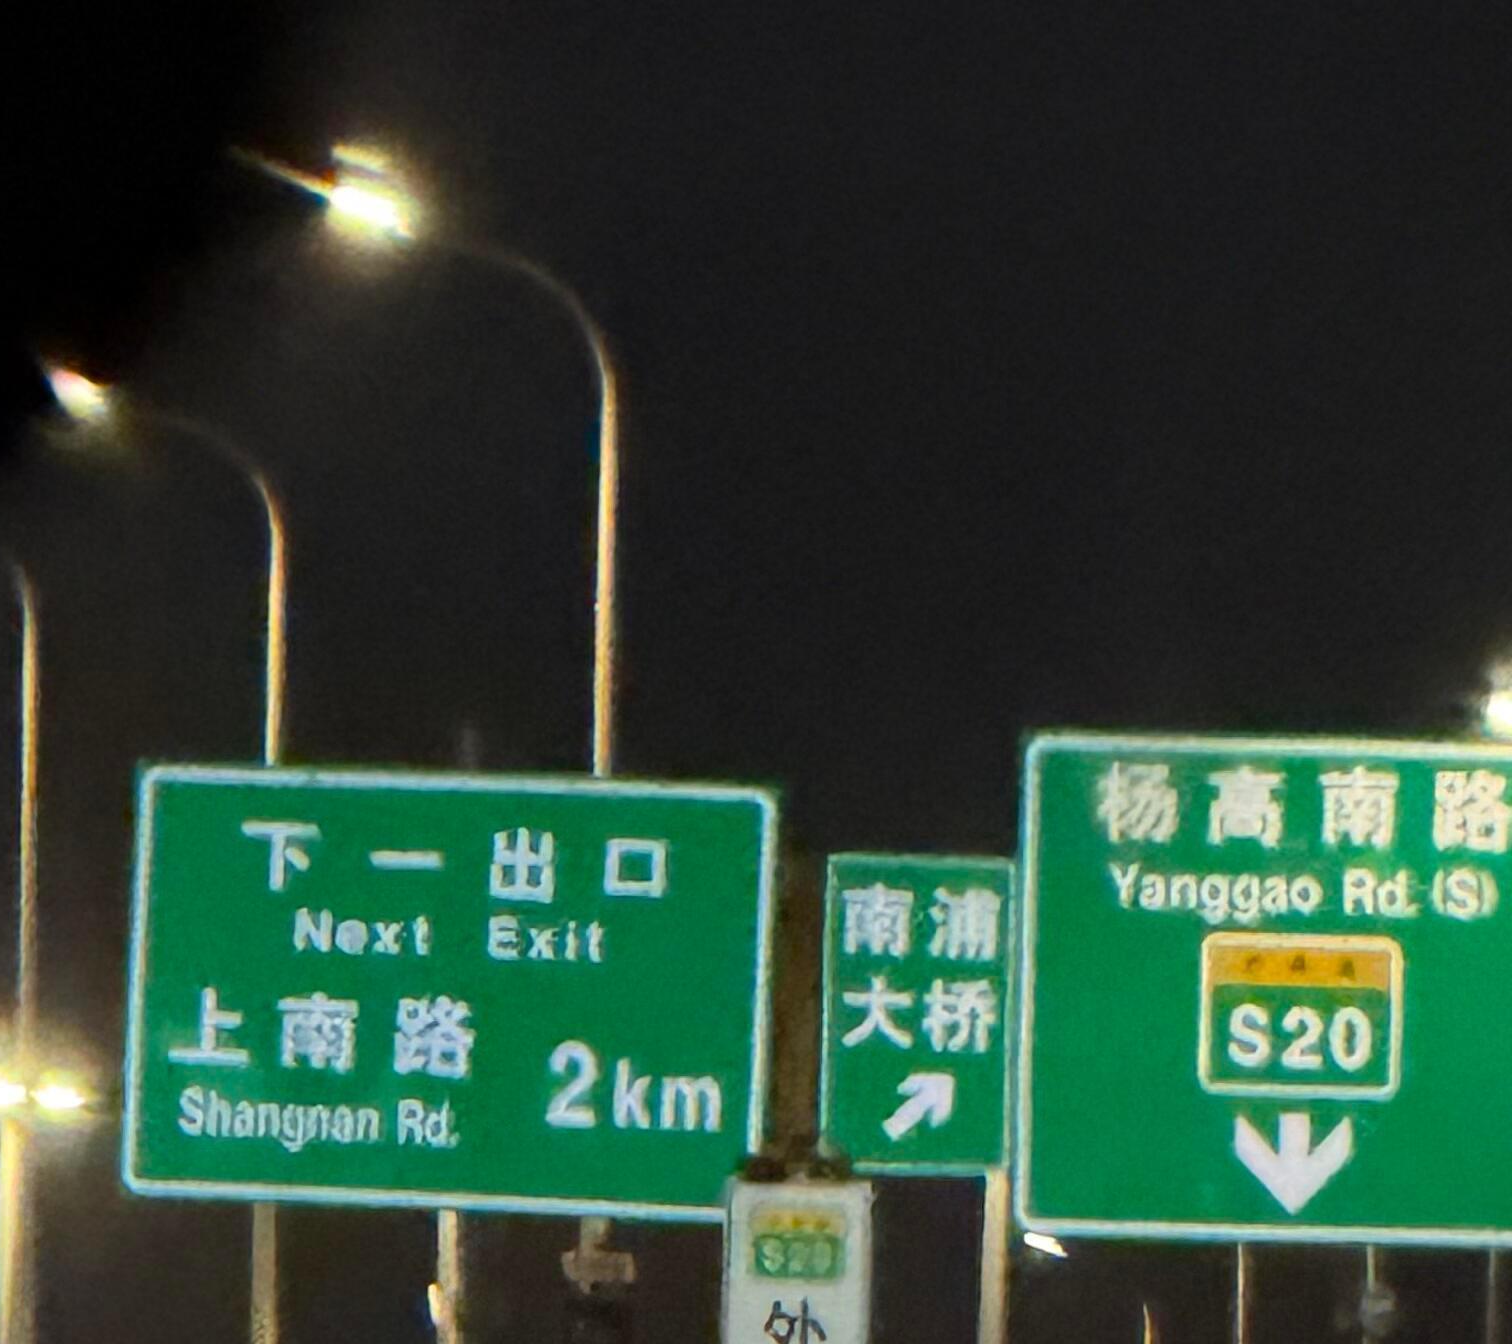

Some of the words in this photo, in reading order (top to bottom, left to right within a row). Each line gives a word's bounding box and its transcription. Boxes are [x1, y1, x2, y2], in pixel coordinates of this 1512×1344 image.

[1097, 760, 1511, 855] 杨高南路
[241, 820, 669, 904] 下一出口
[1108, 862, 1324, 927] Yanggao
[1431, 866, 1500, 921] (S)
[293, 907, 431, 956] Next
[487, 914, 605, 963] Exit
[841, 882, 1003, 962] 南浦
[167, 985, 476, 1079] 上南路
[841, 972, 998, 1053] 大桥
[1227, 1002, 1373, 1073] S20
[177, 1085, 381, 1153] Shangnan
[544, 1039, 724, 1134] 2km
